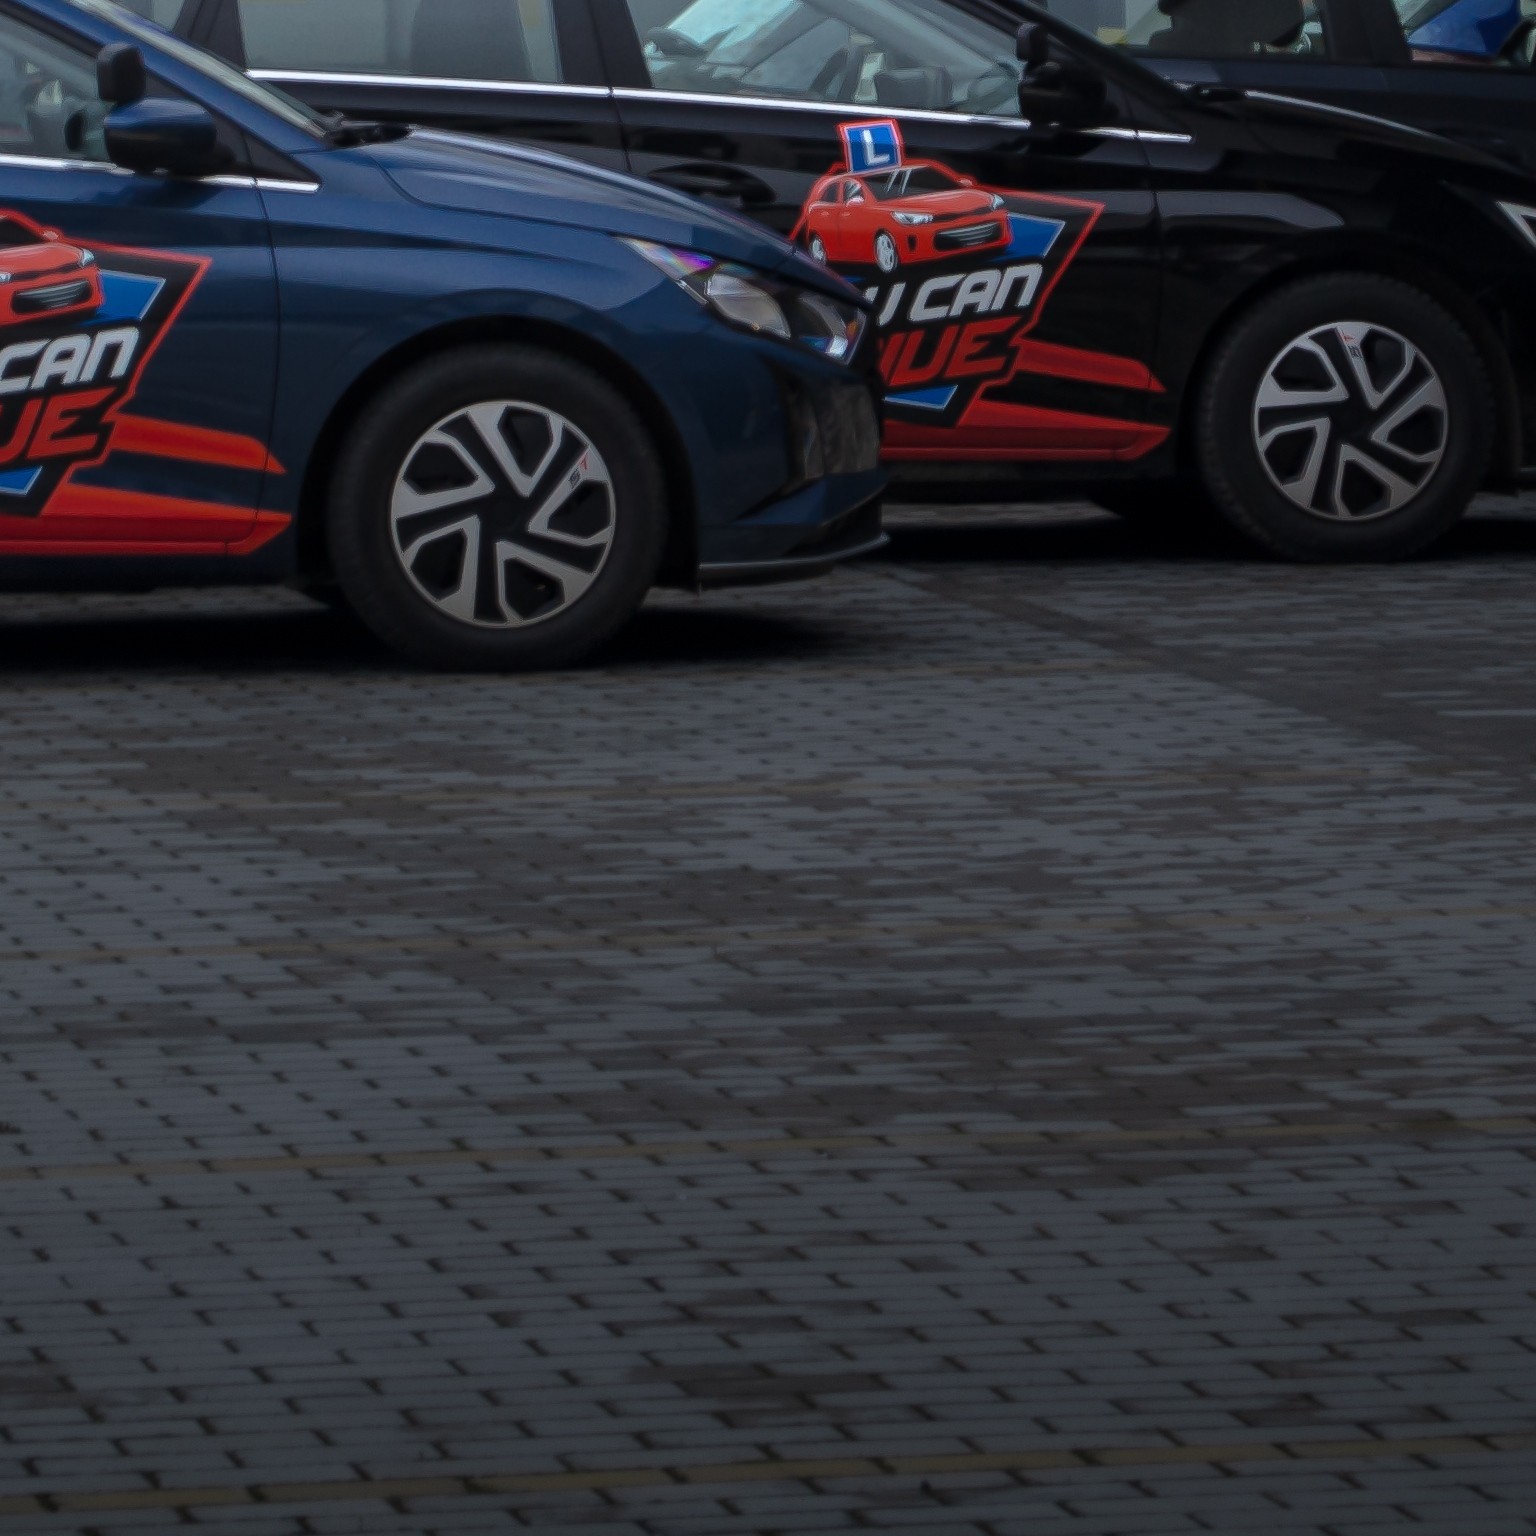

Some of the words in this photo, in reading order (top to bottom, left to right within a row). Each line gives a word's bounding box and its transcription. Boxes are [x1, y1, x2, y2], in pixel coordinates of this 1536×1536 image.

[863, 129, 890, 165] L
[907, 263, 1043, 322] CAN
[877, 315, 1024, 387] IVE
